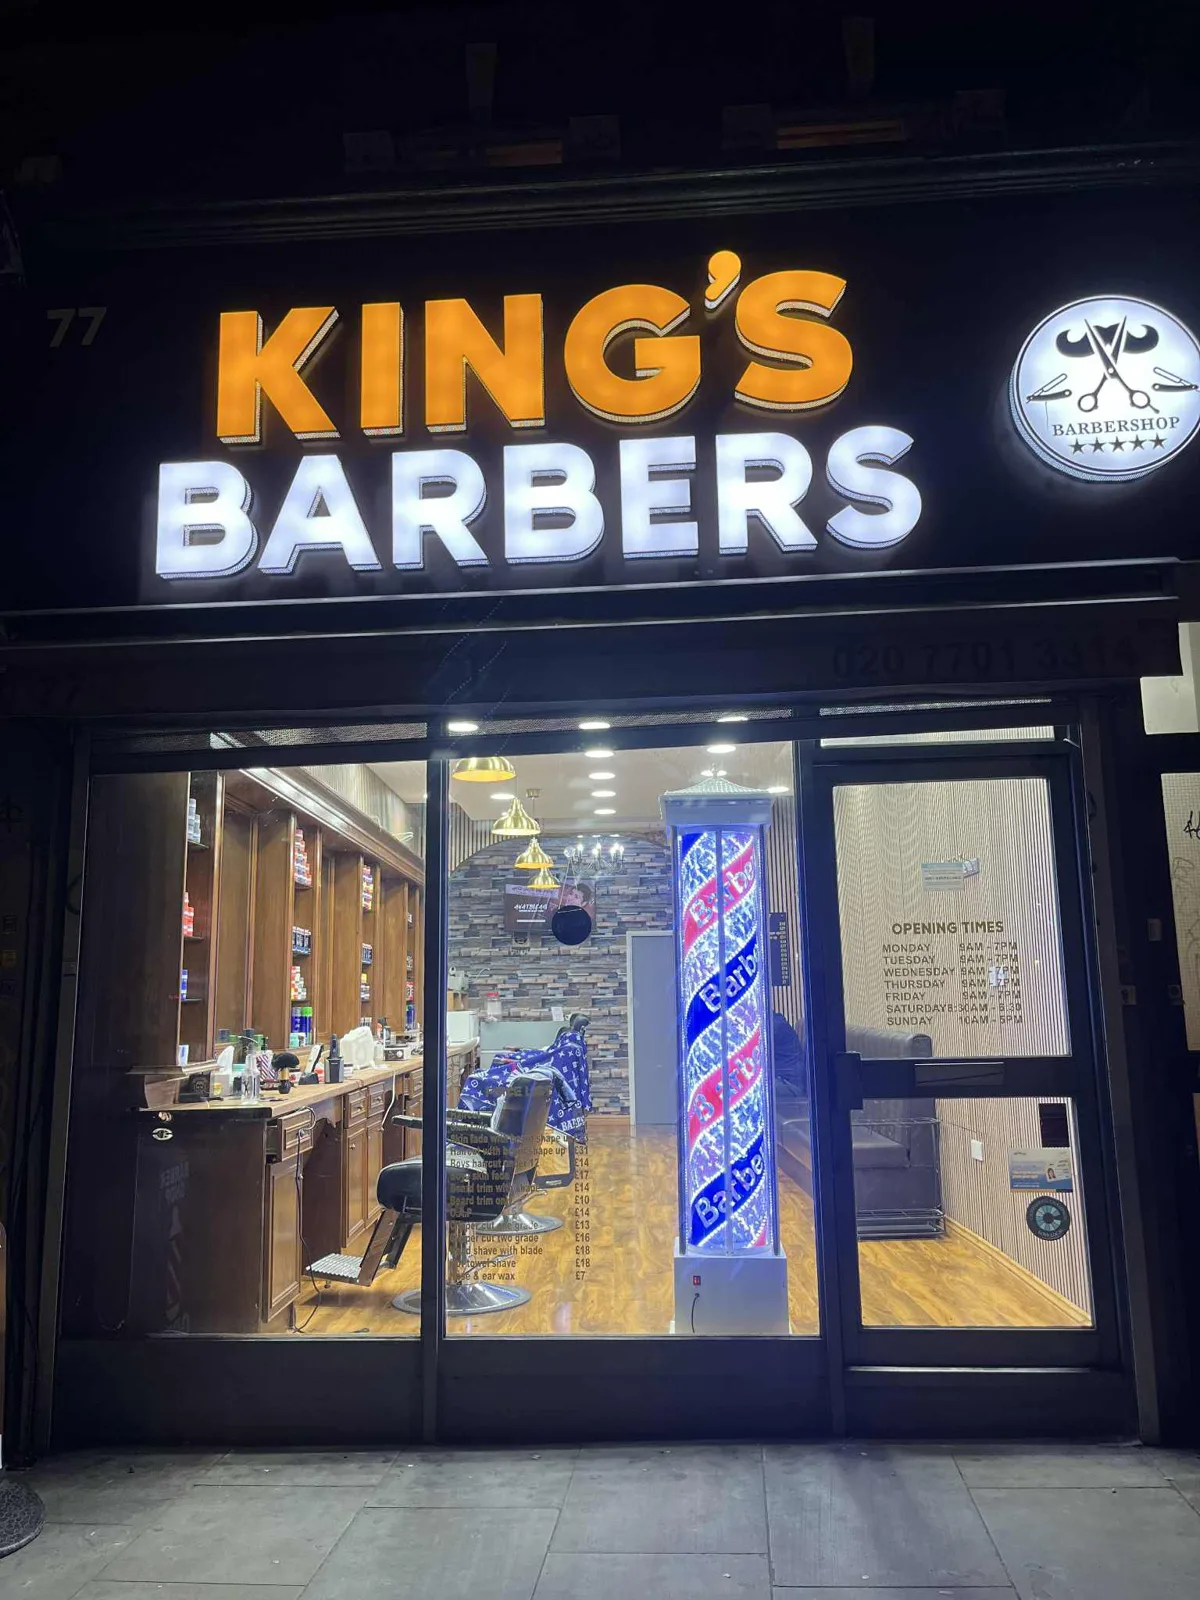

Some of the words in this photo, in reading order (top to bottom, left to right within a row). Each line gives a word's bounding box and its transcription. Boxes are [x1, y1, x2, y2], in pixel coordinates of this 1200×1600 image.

[46, 306, 107, 348] 77
[216, 250, 855, 446] KING'S
[1052, 416, 1180, 437] BARBERSHOP
[154, 424, 924, 580] BARBERS
[891, 922, 958, 935] OPENING
[961, 920, 1005, 934] TIMES
[882, 943, 931, 953] MONDAY
[959, 942, 984, 952] 9AM
[883, 955, 936, 965] TUESDAY
[960, 954, 985, 963] 9AM
[883, 967, 956, 976] WEDNESDAY
[961, 966, 986, 976] 9AM
[884, 979, 946, 989] THURSDAY
[962, 978, 987, 988] 9AM
[885, 991, 926, 1001] FRIDAY
[963, 991, 988, 1000] 9AM
[886, 1004, 947, 1014] SATURDAY
[887, 1016, 933, 1026] SUNDAY
[555, 1147, 566, 1158] up
[575, 1145, 588, 1155] £31
[450, 1159, 470, 1169] Boys
[472, 1158, 500, 1167] haircut
[574, 1158, 589, 1167] £14
[574, 1171, 589, 1179] £17
[574, 1183, 589, 1192] £14
[450, 1195, 474, 1205] Beard
[476, 1195, 494, 1205] trim
[574, 1195, 590, 1205] £10
[574, 1208, 590, 1217] £14
[575, 1220, 590, 1230] £13
[482, 1234, 495, 1243] cut
[497, 1235, 513, 1243] two
[515, 1234, 539, 1245] grade
[575, 1232, 590, 1242] £16
[474, 1246, 498, 1255] shave
[500, 1245, 518, 1255] with
[520, 1245, 543, 1255] blade
[575, 1245, 591, 1255] £18
[575, 1257, 591, 1268] £18
[482, 1273, 496, 1281] ear
[498, 1273, 516, 1281] wax
[575, 1270, 586, 1281] £7
